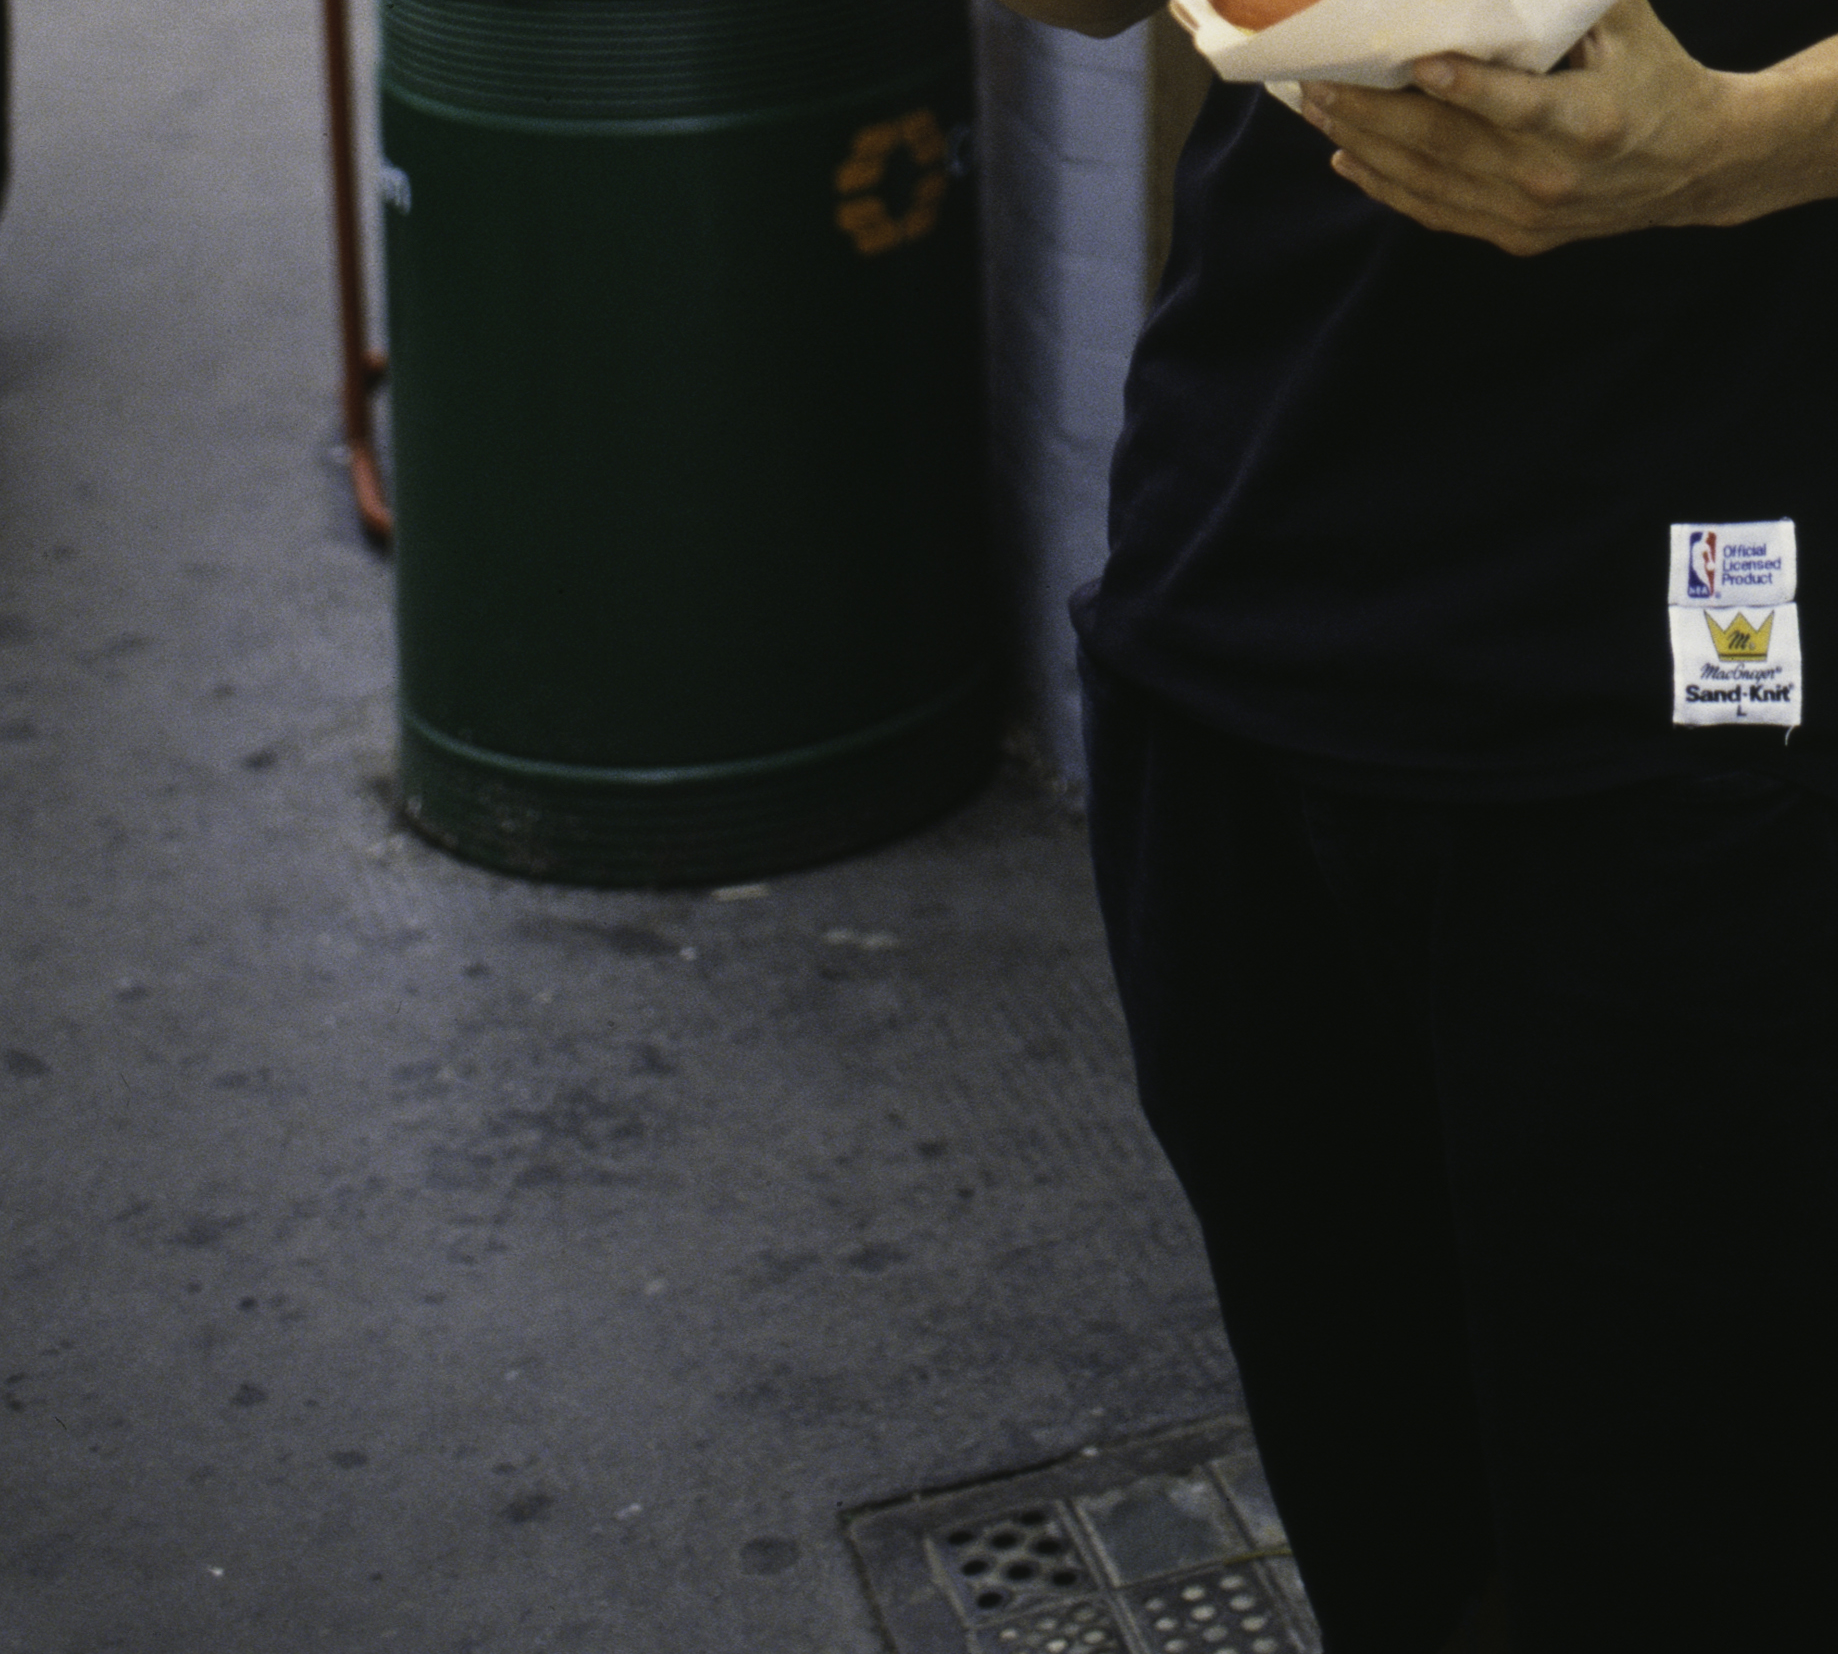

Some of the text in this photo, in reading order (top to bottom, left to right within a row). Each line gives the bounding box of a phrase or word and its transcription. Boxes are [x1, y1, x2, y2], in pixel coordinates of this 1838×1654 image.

[1722, 542, 1767, 559] Official
[1722, 556, 1782, 573] Licensed
[1721, 572, 1773, 586] Product
[1736, 704, 1748, 718] L
